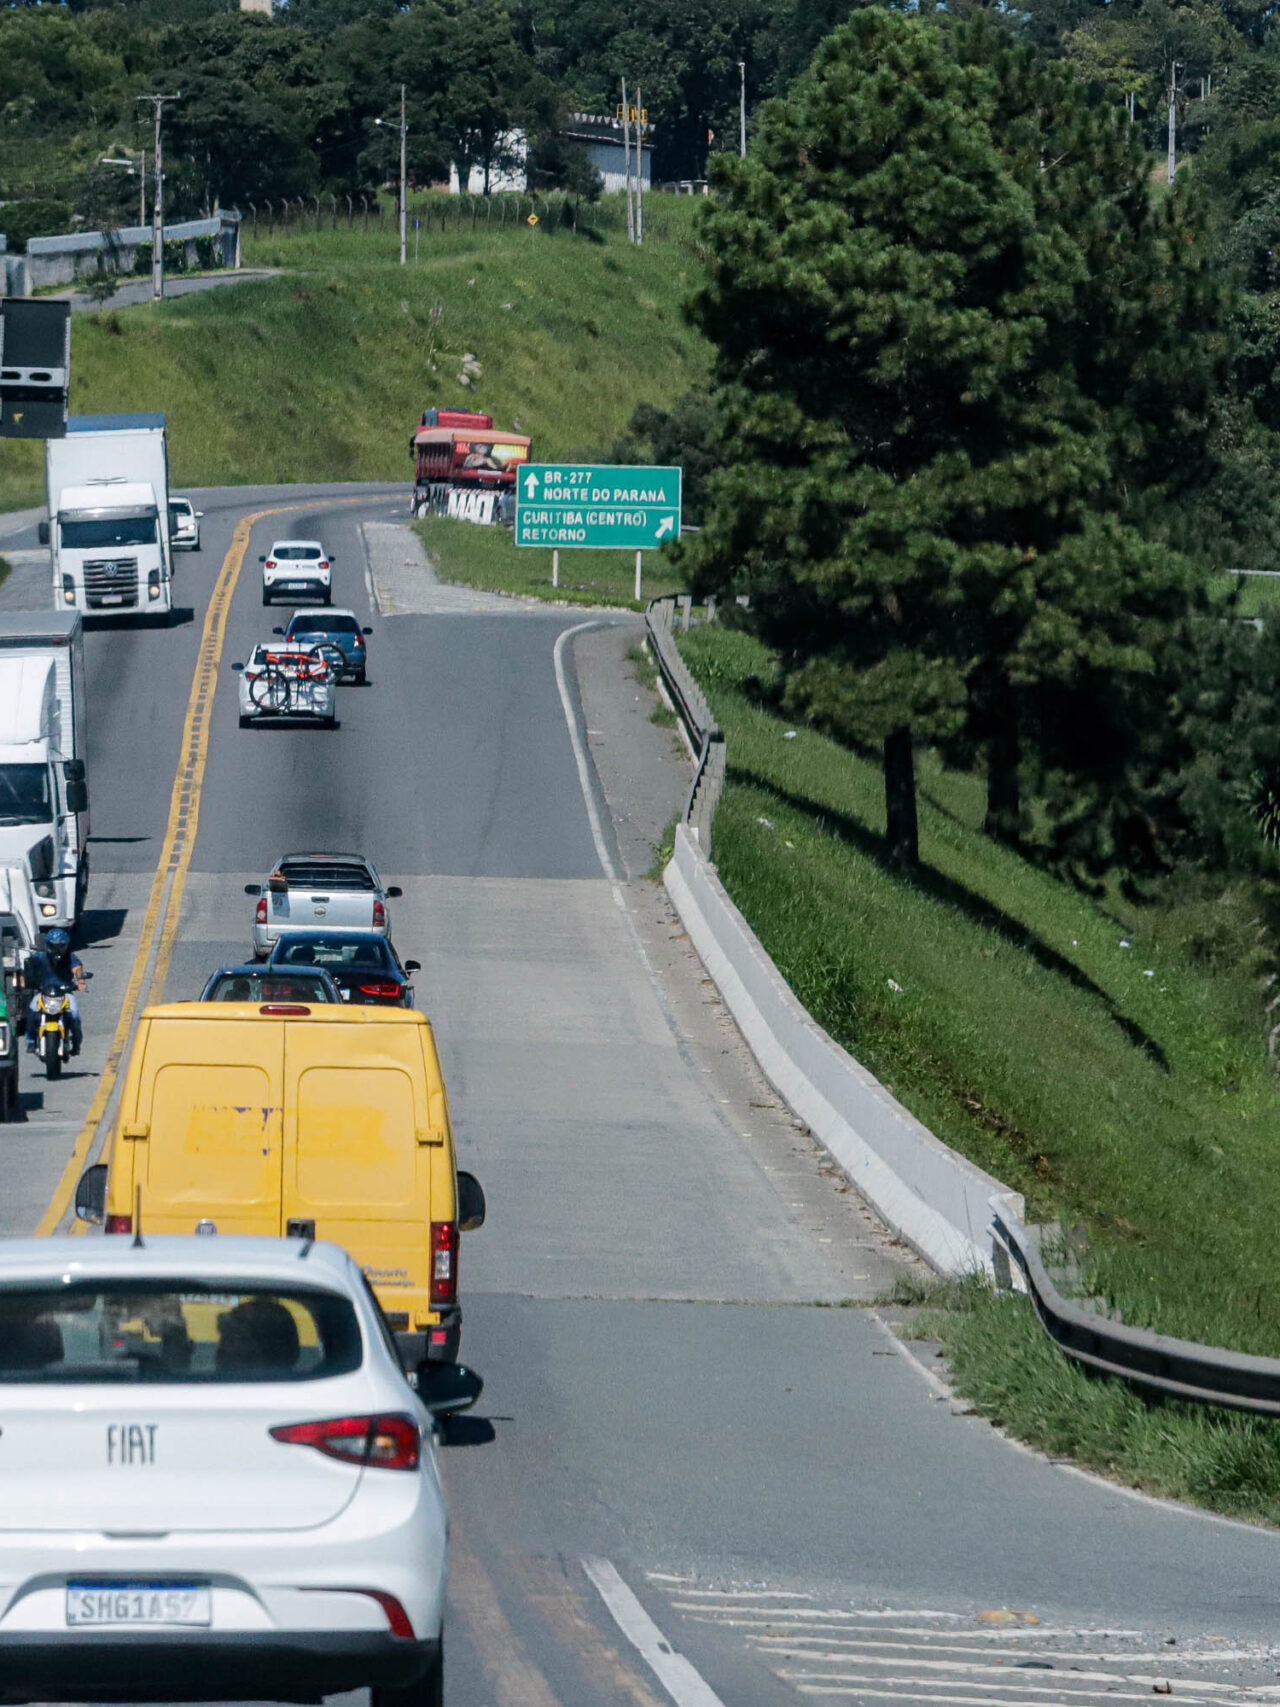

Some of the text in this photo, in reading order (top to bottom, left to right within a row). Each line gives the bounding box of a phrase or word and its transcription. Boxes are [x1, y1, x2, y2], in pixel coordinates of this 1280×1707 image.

[543, 488, 666, 503] NORTE DO PARANÁ
[523, 511, 647, 528] CURITIBA (CENTRO)
[522, 528, 586, 541] RETORNO
[106, 1423, 160, 1466] FIAT
